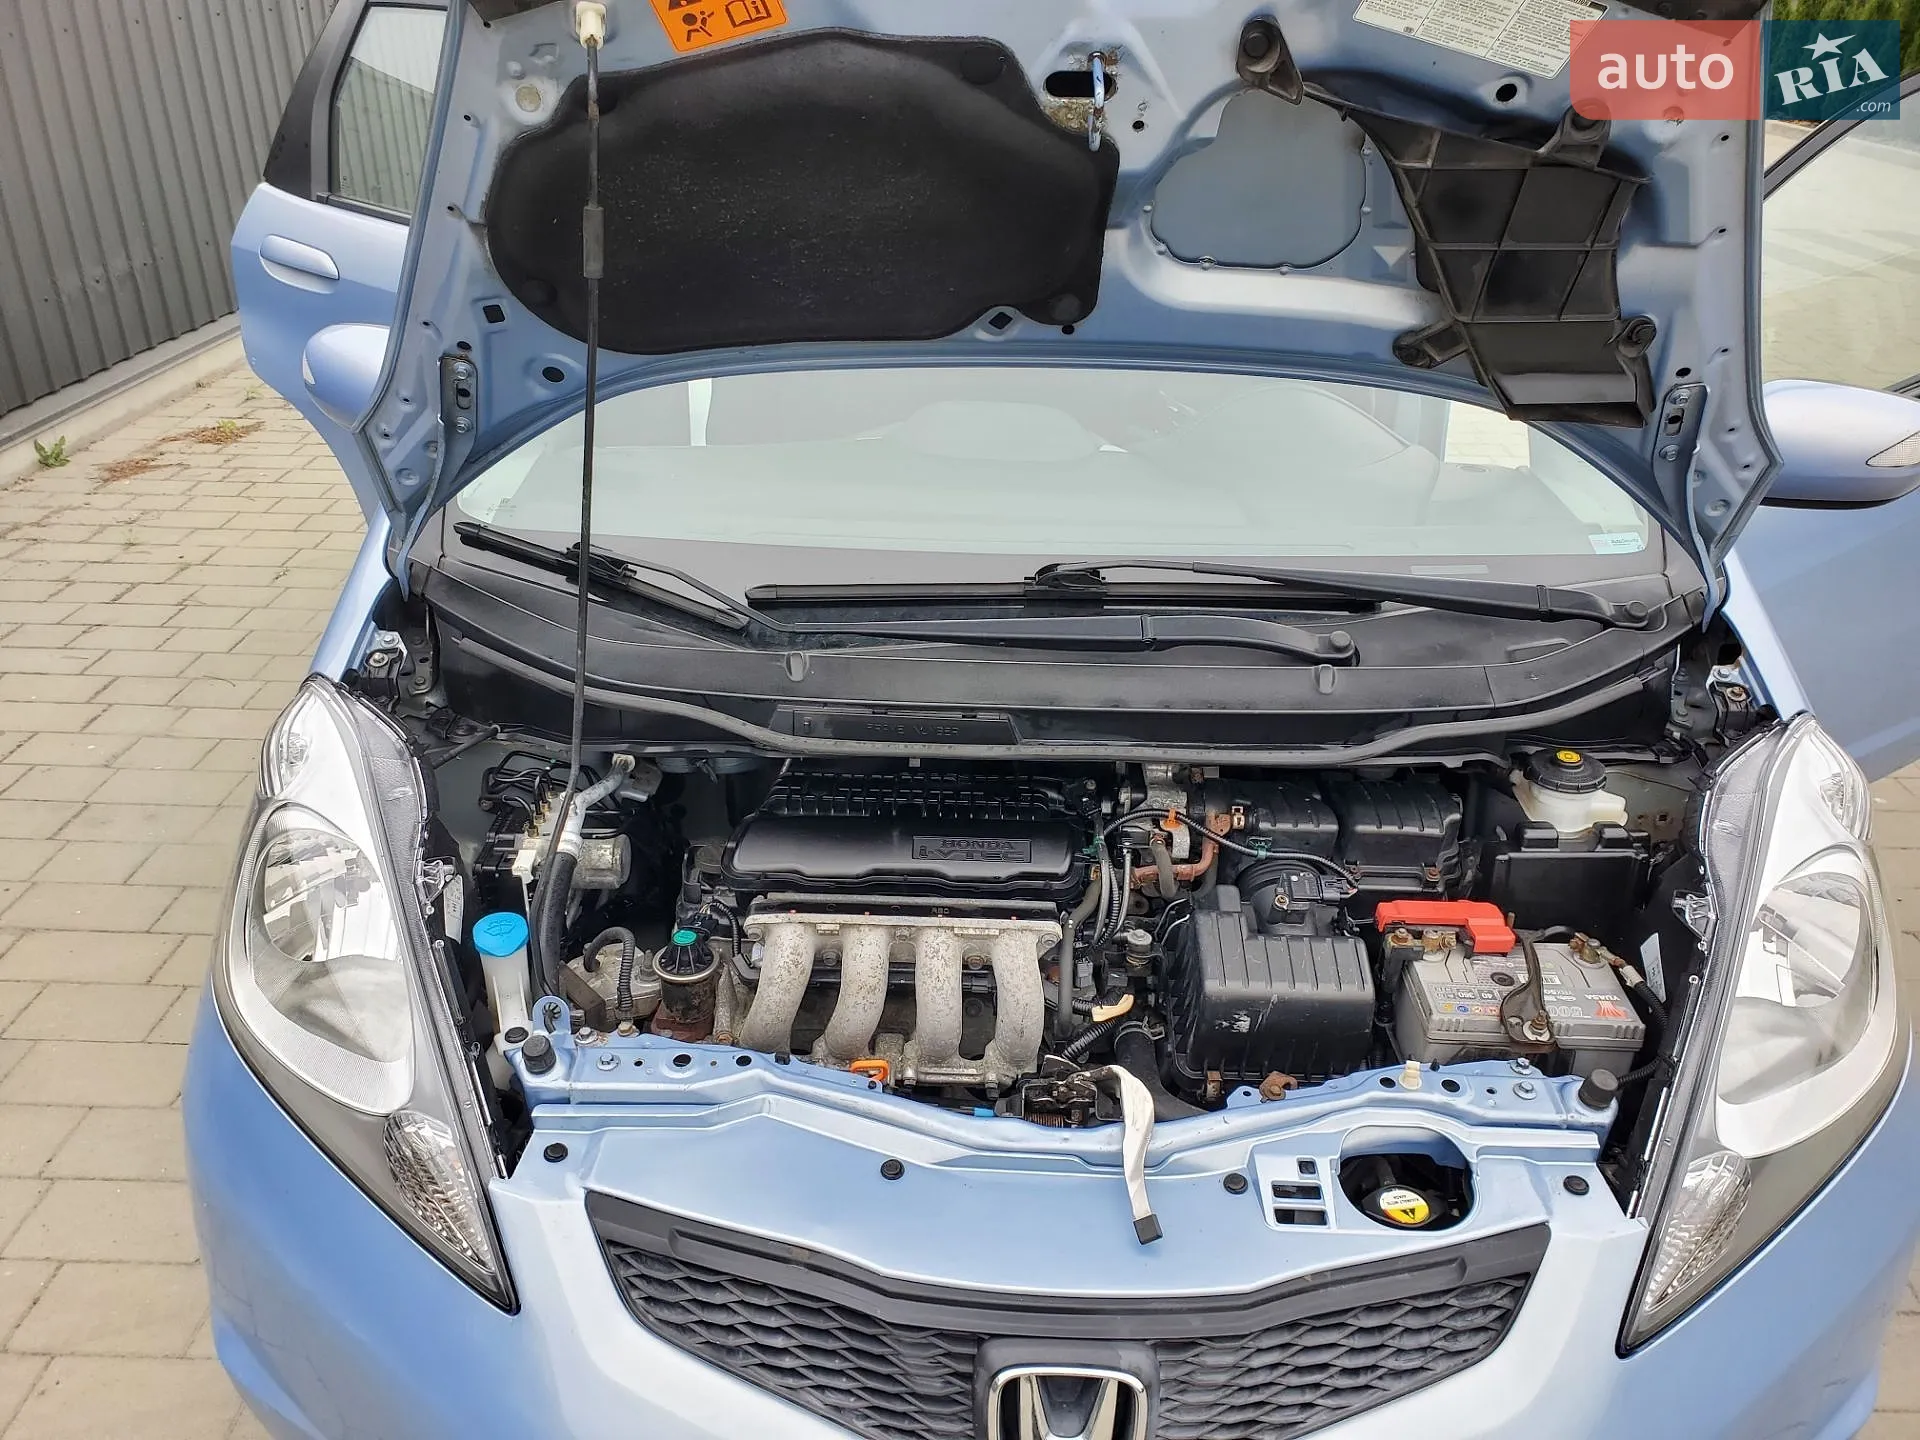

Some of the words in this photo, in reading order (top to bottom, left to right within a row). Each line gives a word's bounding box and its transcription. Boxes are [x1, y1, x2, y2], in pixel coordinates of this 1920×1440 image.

[865, 722, 906, 735] FRAE
[912, 724, 961, 738] NUBER
[940, 839, 1015, 851] HONDA
[1584, 993, 1621, 1002] YUASA
